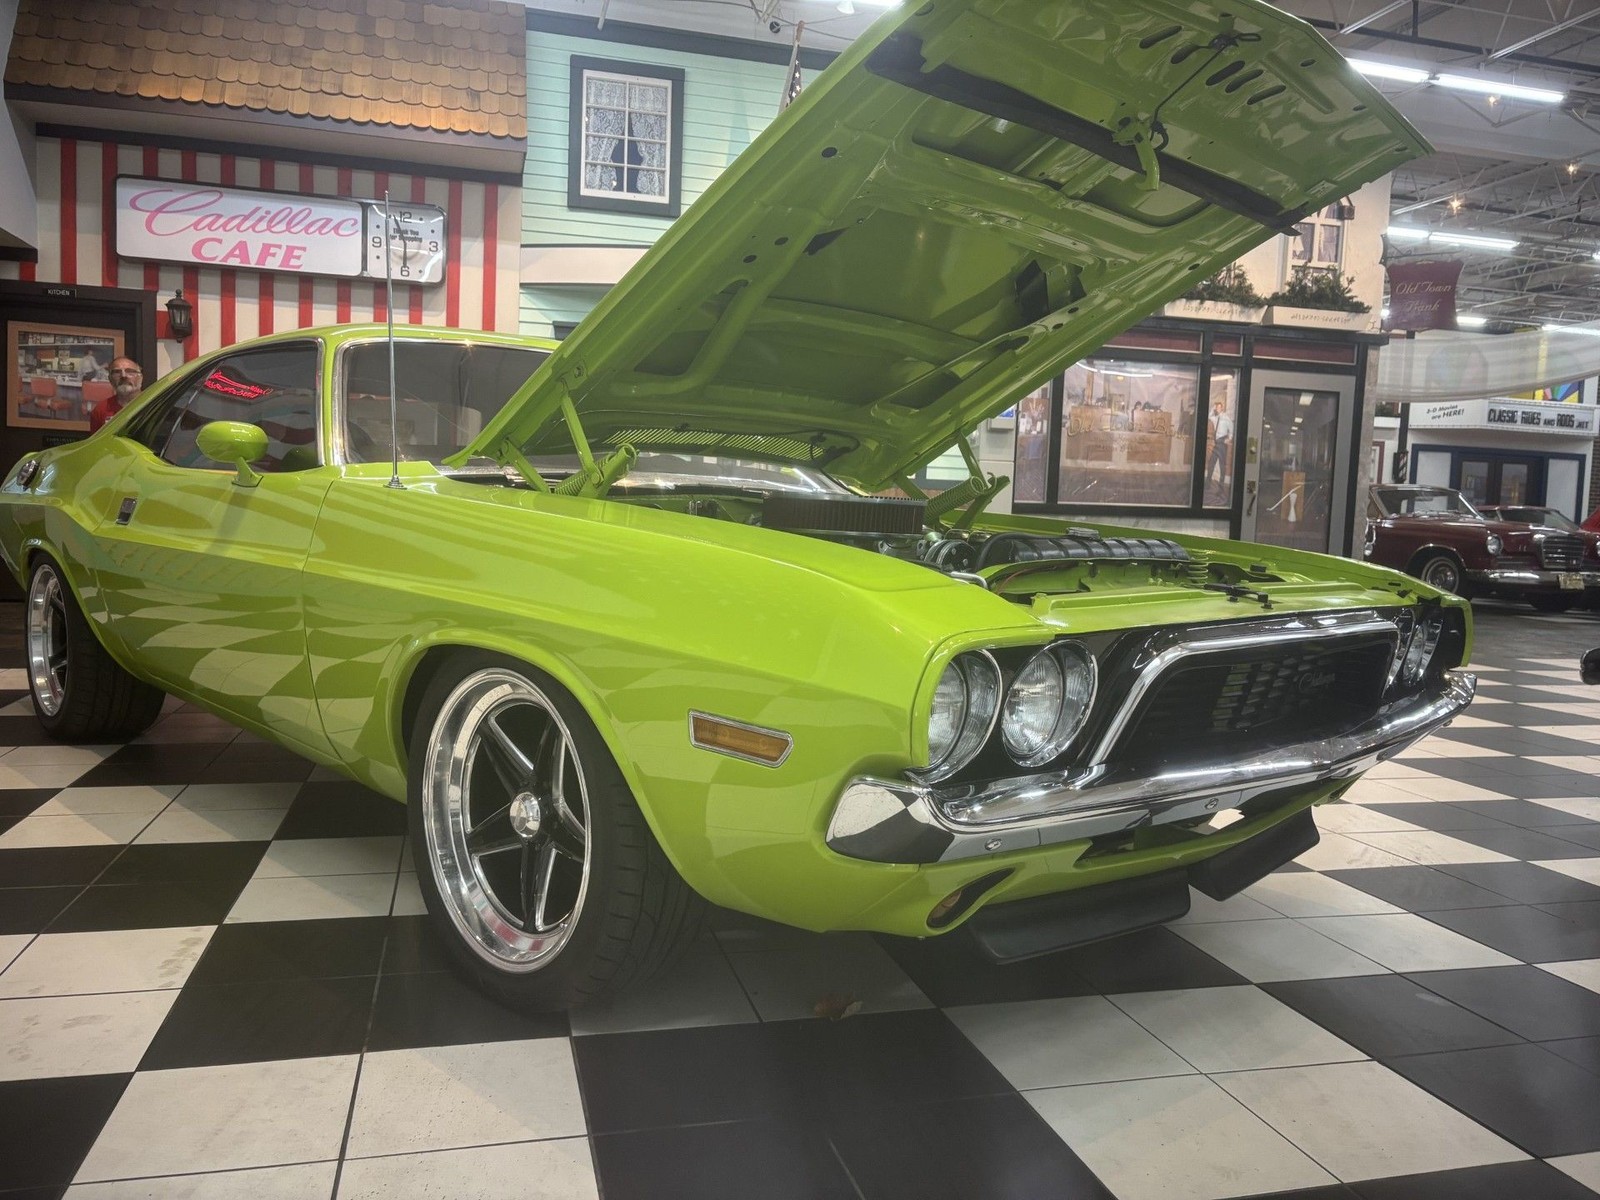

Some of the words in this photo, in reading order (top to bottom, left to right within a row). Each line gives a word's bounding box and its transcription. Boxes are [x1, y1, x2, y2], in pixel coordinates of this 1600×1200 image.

[129, 189, 359, 237] Cadillac
[399, 211, 412, 224] 12
[393, 227, 409, 235] Thnk
[372, 236, 382, 248] 9
[398, 235, 422, 243] Sopping
[429, 241, 439, 253] 3
[191, 237, 308, 270] CAFE
[400, 265, 410, 277] 6
[1395, 282, 1420, 295] Old
[1421, 281, 1452, 292] Town
[1438, 404, 1458, 412] Movies
[1442, 408, 1465, 418] HERE!
[1487, 408, 1518, 424] CLASSIC
[1520, 411, 1542, 426] RIDES
[1543, 418, 1556, 427] AND
[1556, 413, 1575, 428] RODS
